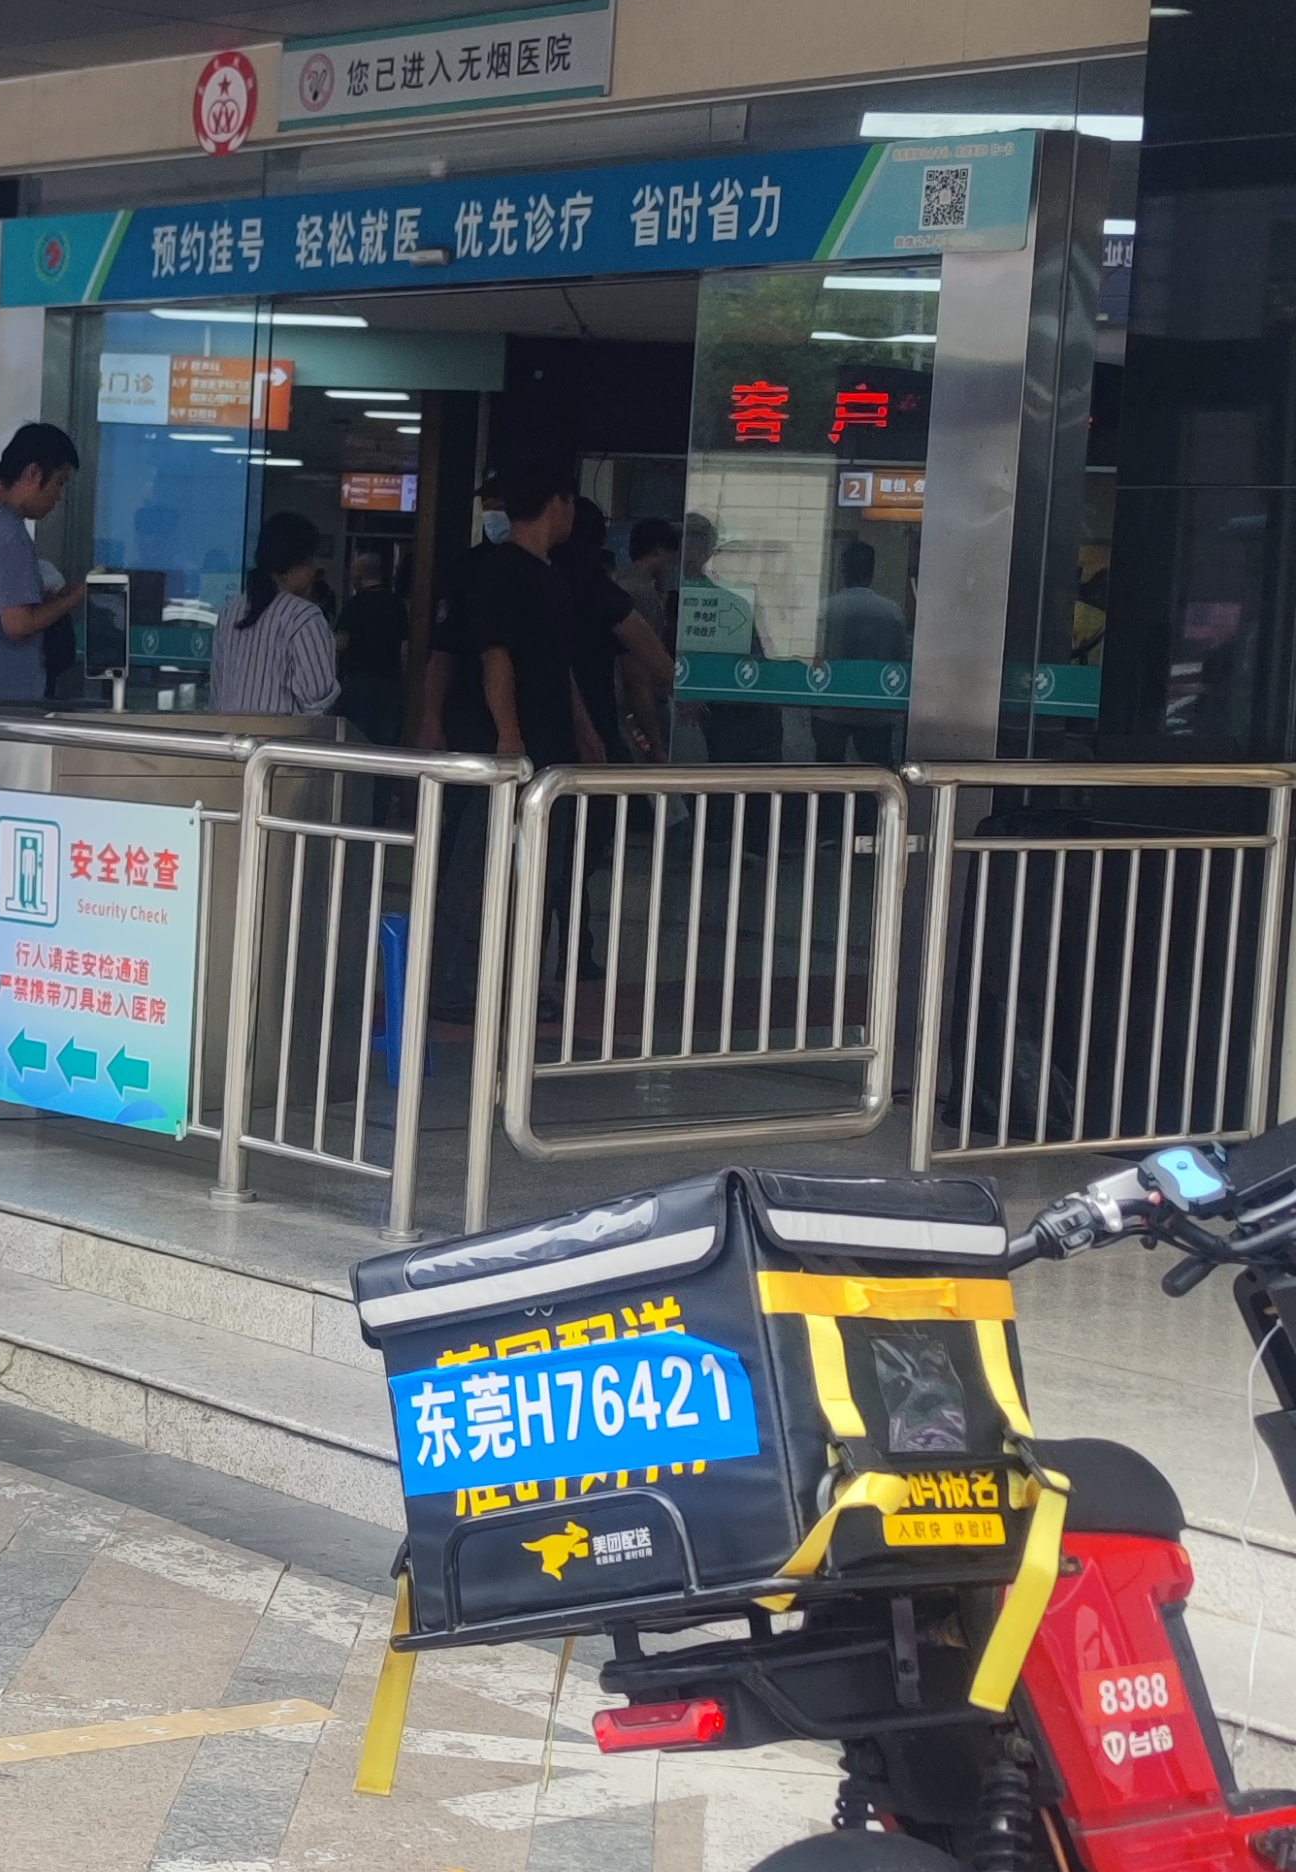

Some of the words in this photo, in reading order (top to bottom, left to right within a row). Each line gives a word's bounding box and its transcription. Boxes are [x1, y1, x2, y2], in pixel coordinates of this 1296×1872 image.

[346, 33, 574, 97] 您已进入无烟医院
[151, 217, 265, 279] 预约挂号
[296, 207, 421, 270] 轻松就医
[454, 192, 595, 258] 优先诊疗
[630, 176, 783, 248] 省时省力
[848, 480, 861, 499] 2
[68, 839, 181, 892] 安全检查
[77, 898, 128, 923] Security
[130, 904, 168, 925] Check
[15, 940, 151, 987] 行人请走安检通道
[410, 1353, 733, 1468] 东莞H76421
[900, 1470, 999, 1509] 码报名
[591, 1526, 652, 1556] 美团配送
[1098, 1672, 1169, 1715] 8388
